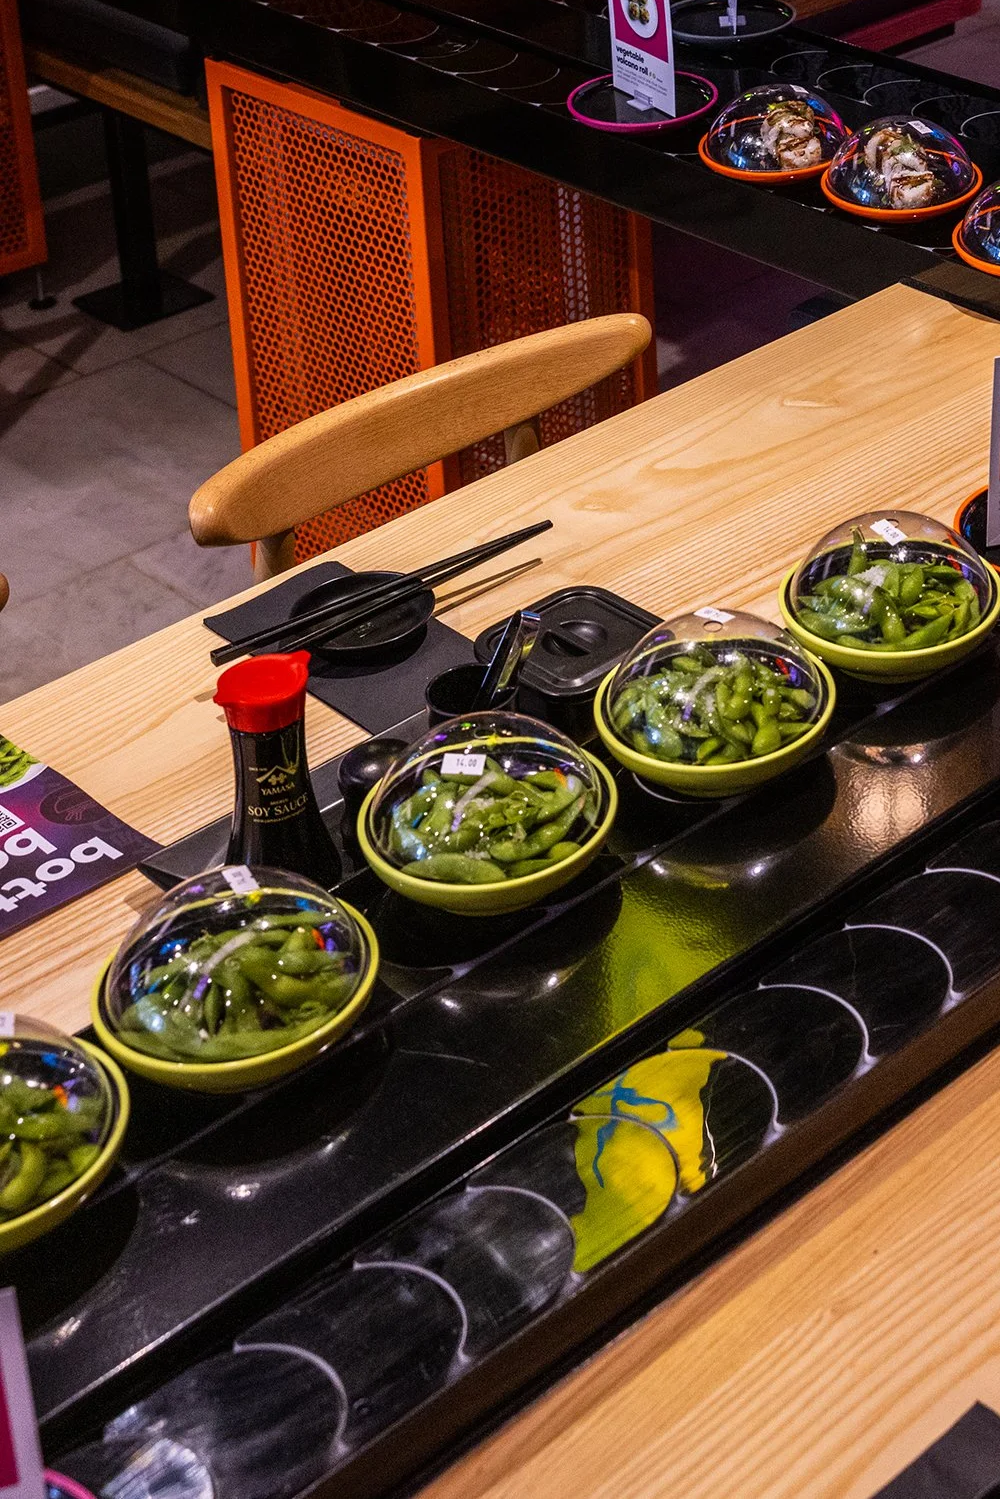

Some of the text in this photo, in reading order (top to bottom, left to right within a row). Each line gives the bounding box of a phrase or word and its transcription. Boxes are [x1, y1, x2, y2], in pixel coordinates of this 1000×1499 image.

[616, 45, 645, 64] vegetable
[639, 65, 649, 76] roll
[261, 781, 295, 796] YAMASA
[248, 805, 270, 817] SOY
